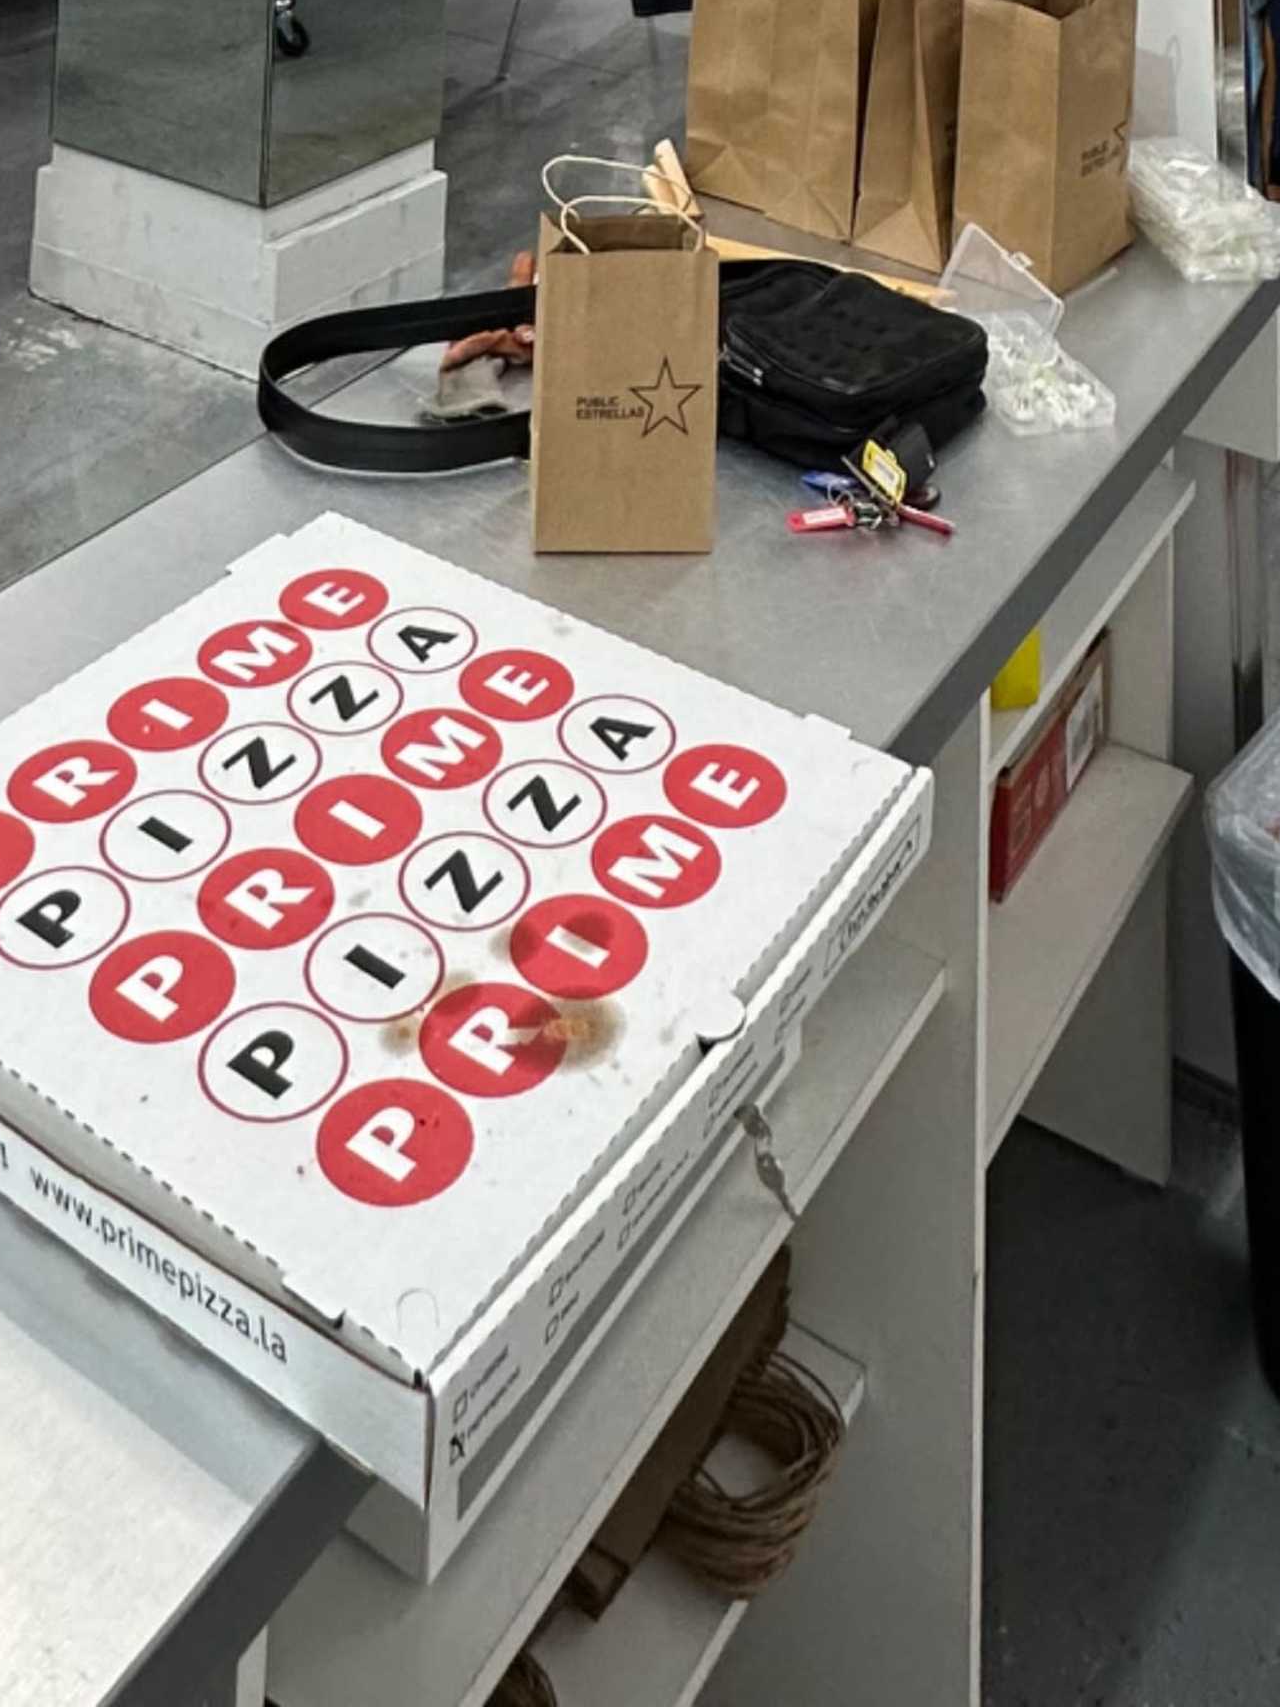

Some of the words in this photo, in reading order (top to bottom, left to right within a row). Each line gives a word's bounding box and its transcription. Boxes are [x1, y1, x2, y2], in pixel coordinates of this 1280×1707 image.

[16, 624, 458, 949] PIZZA
[115, 664, 550, 1023] PRIME
[226, 716, 655, 1099] PIZZA
[345, 762, 760, 1182] PRIME
[30, 1166, 287, 1364] www.primepizza.la
